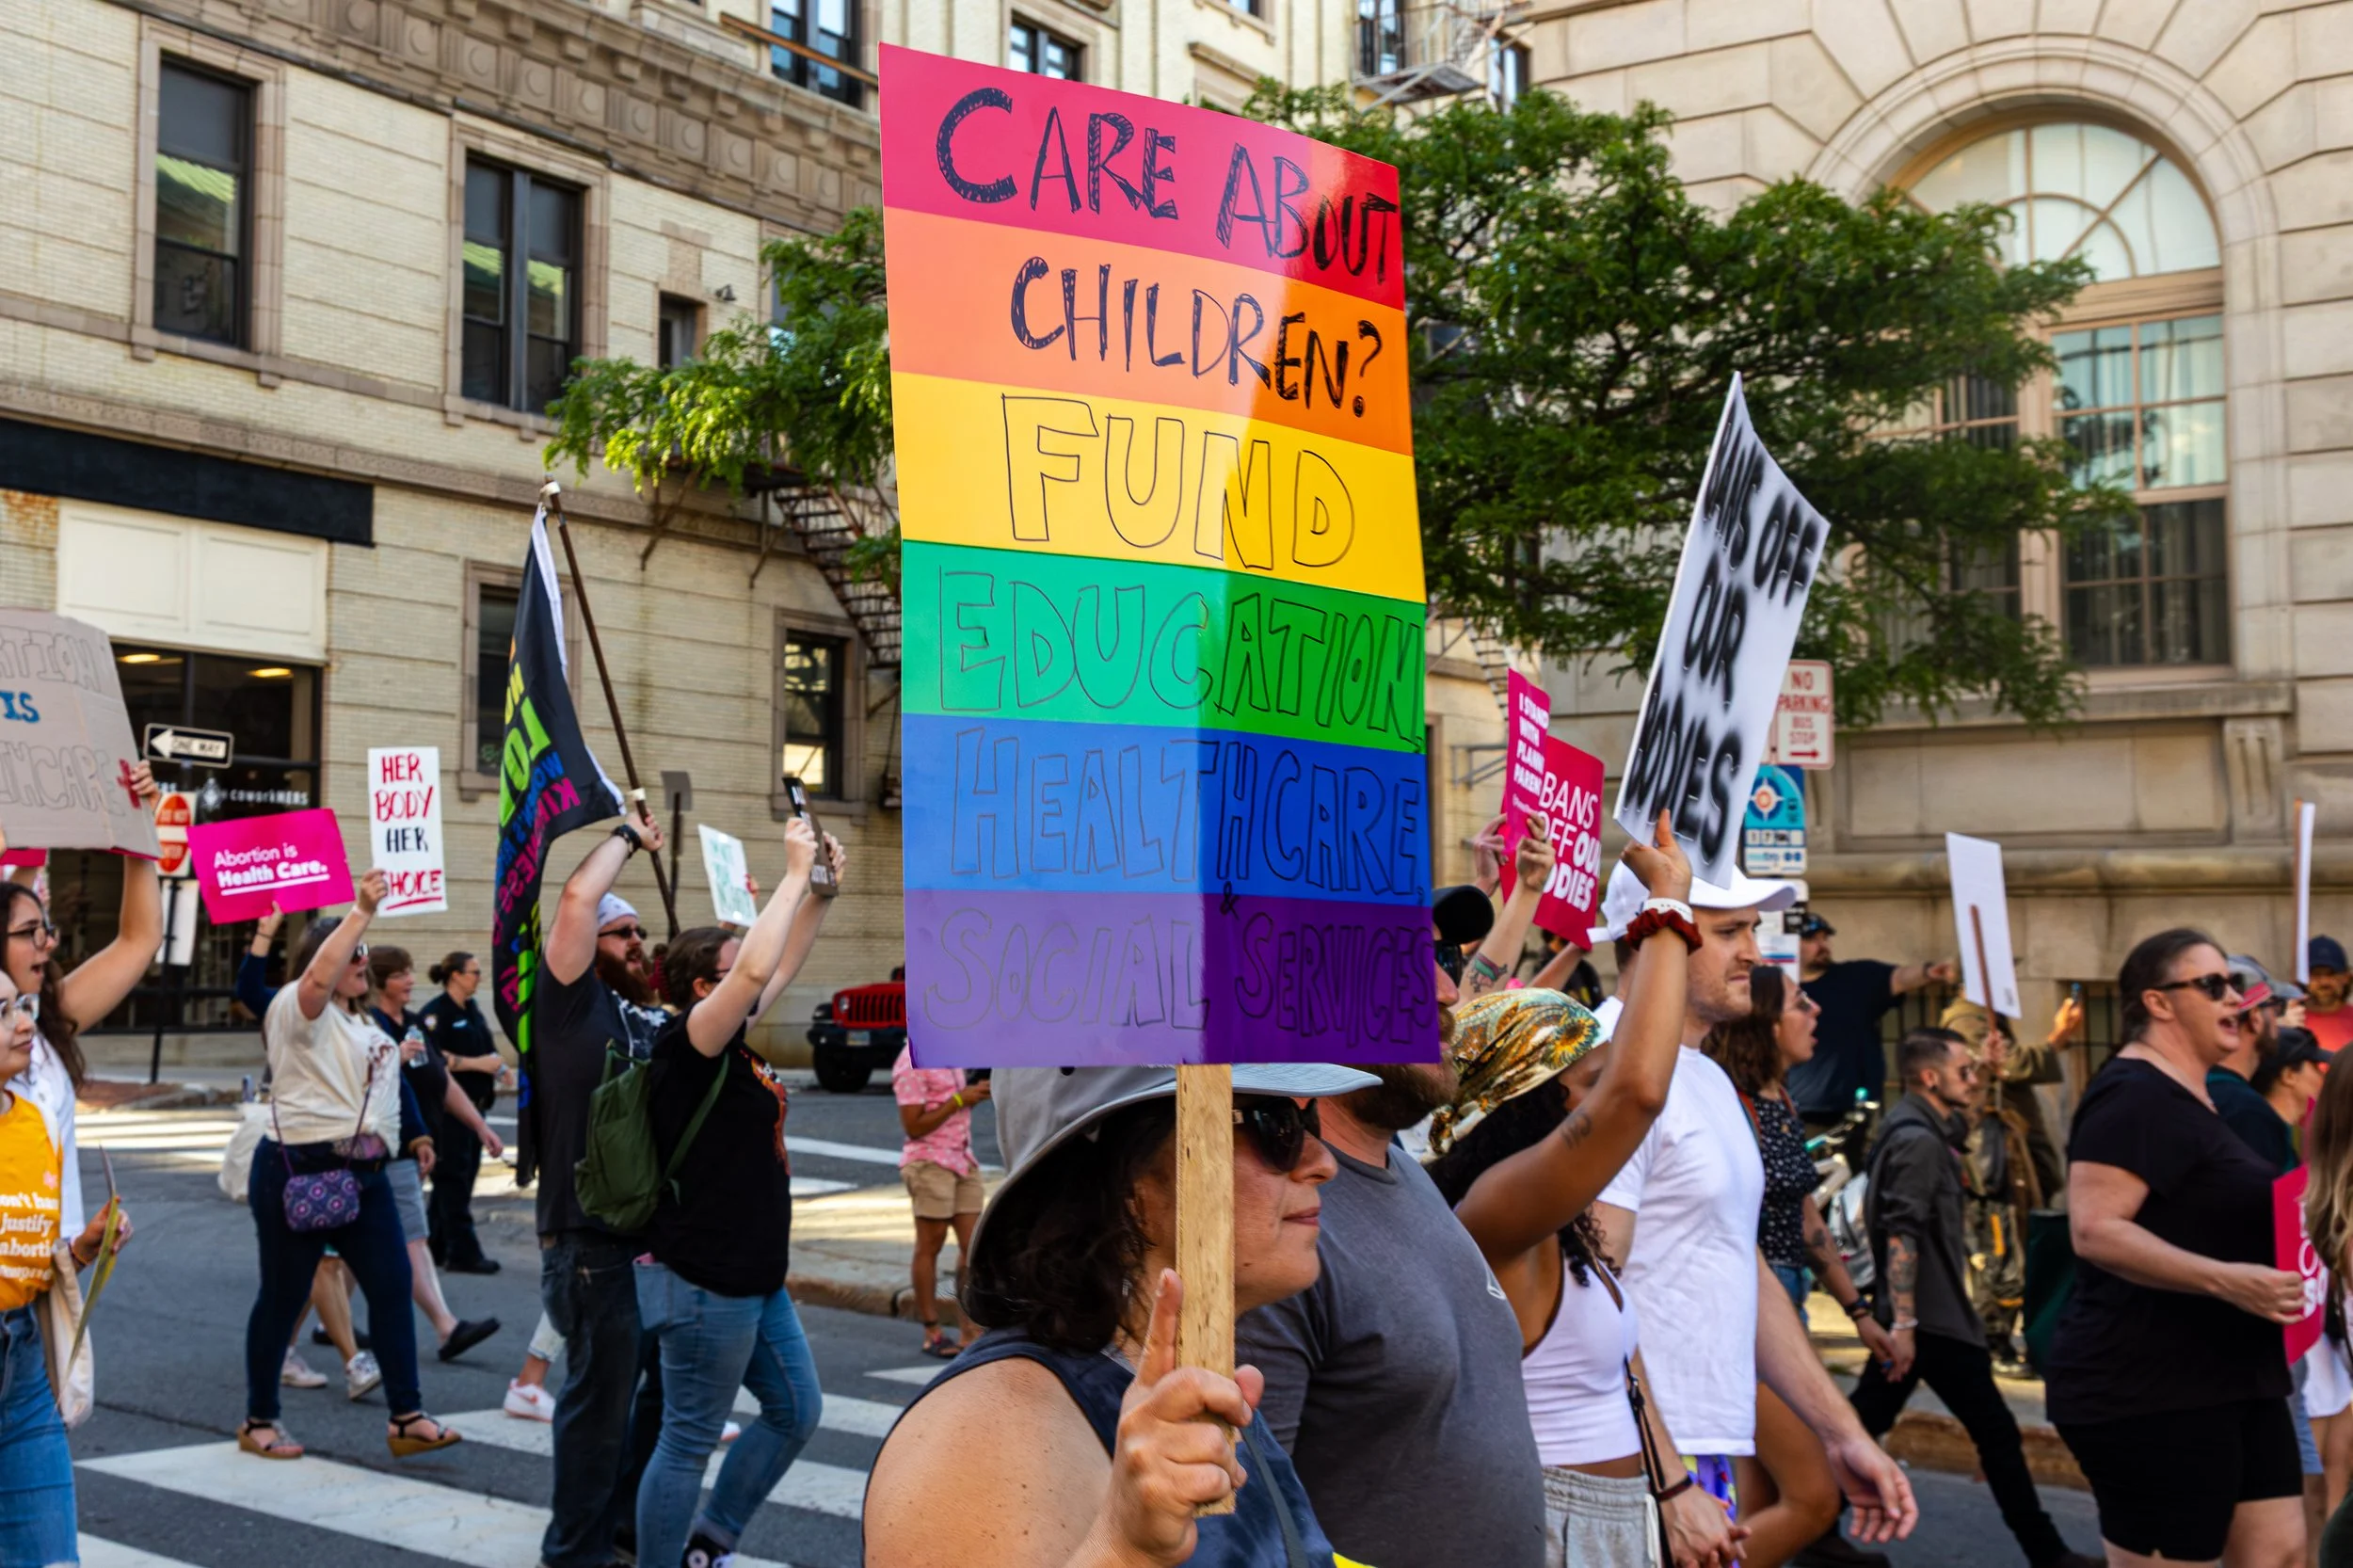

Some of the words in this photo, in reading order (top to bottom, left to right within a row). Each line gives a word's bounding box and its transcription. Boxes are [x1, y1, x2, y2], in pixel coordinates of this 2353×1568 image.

[936, 87, 1178, 219] CARE
[1215, 142, 1399, 284] ABOUT
[1011, 255, 1383, 418] CHILDREN?
[1002, 393, 1354, 570] FUND
[1753, 488, 1819, 606] OFF
[1682, 550, 1748, 712] OUR
[1791, 670, 1814, 691] NO
[1518, 692, 1524, 712] I
[1524, 696, 1550, 730] STAND
[1777, 694, 1830, 712] PARKING
[199, 742, 220, 753] WAY
[1519, 716, 1540, 747] WITH
[381, 753, 423, 784] HER
[1515, 739, 1545, 776] PLANN
[1623, 659, 1743, 866] BODIES
[1513, 763, 1542, 799] PAREN
[376, 784, 433, 823] BODY
[1538, 771, 1598, 831] BANS
[214, 846, 280, 869] Abortion
[282, 841, 298, 858] is
[386, 826, 428, 854] HER
[216, 864, 275, 888] Health
[276, 859, 328, 880] Care.
[385, 870, 442, 898] HOICE
[1221, 881, 1240, 920] &
[923, 907, 1210, 1031] SOCIAL
[1234, 911, 1436, 1048] SERVICES
